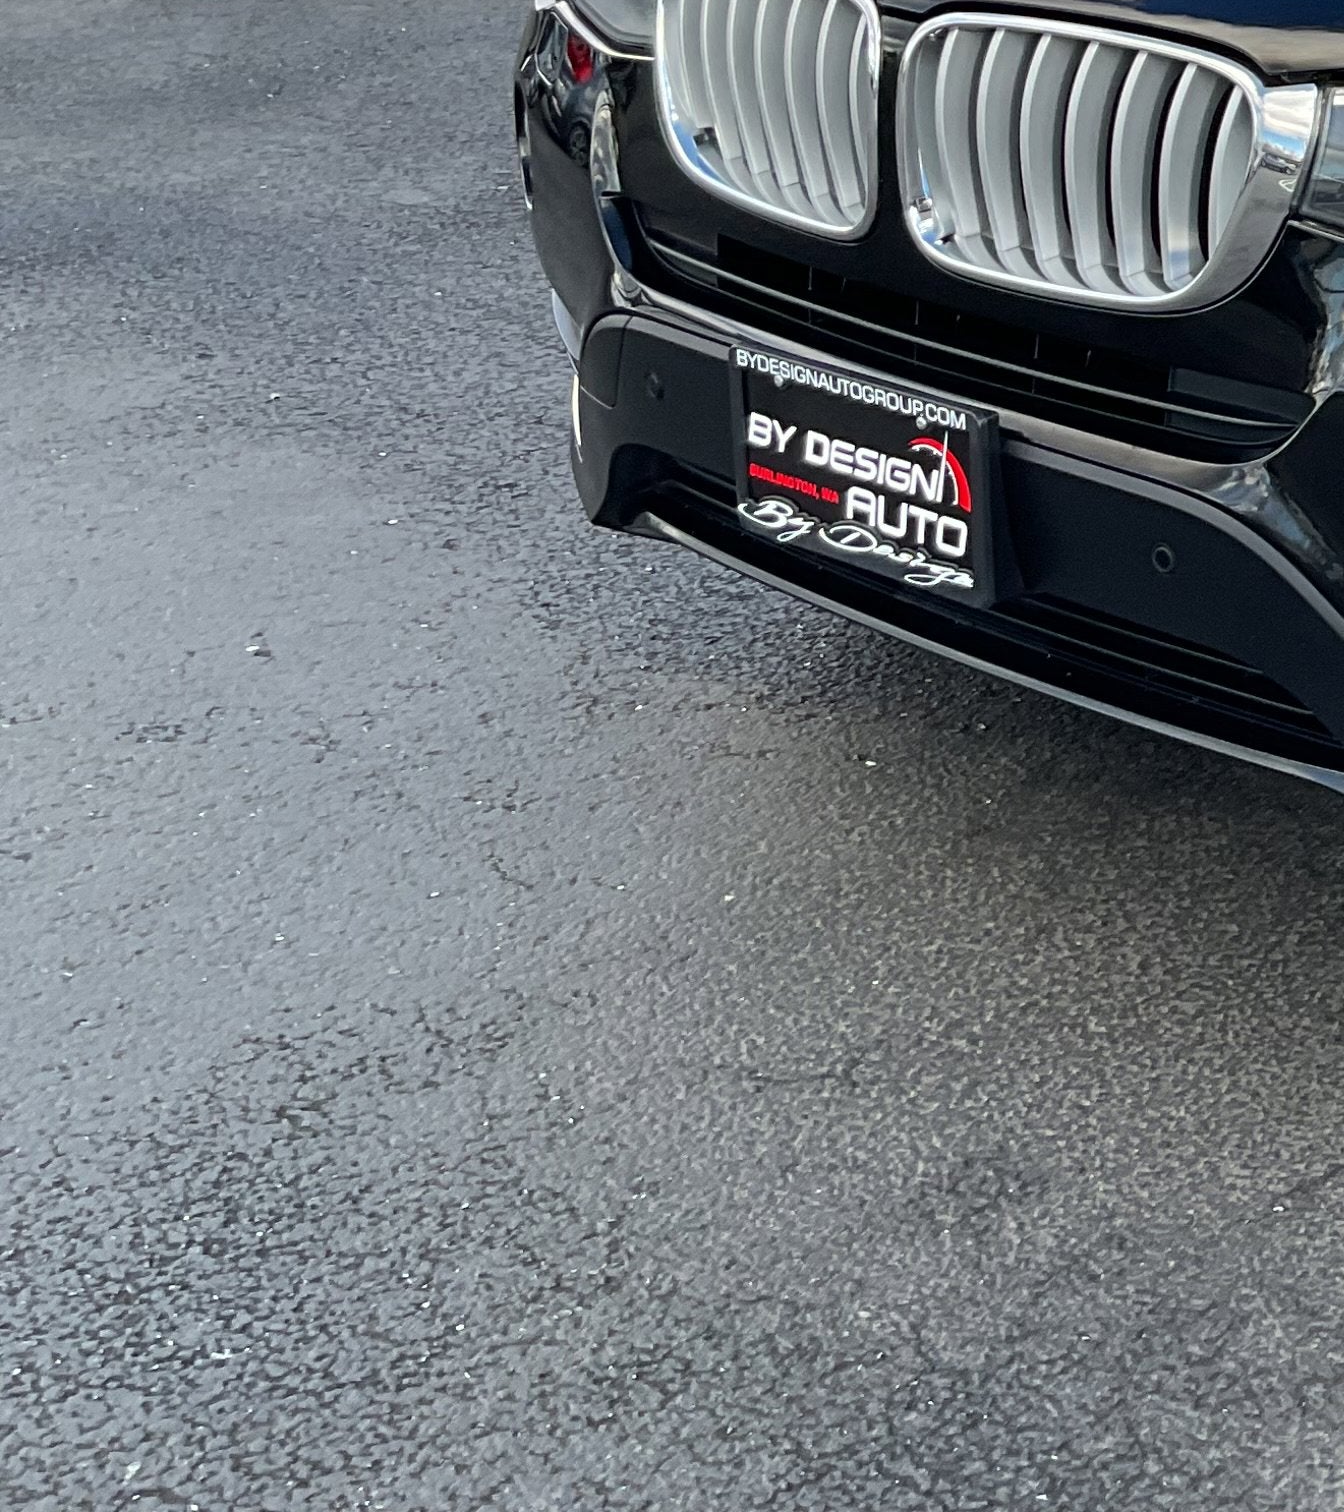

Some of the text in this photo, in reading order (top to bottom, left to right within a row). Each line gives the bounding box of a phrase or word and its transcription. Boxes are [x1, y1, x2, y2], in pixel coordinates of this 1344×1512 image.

[736, 348, 967, 430] BYDESIGNAUTOGROUP.COM
[747, 411, 940, 503] BY DESIGN
[737, 499, 815, 543] By
[821, 487, 839, 505] WA
[845, 485, 968, 557] AUTO
